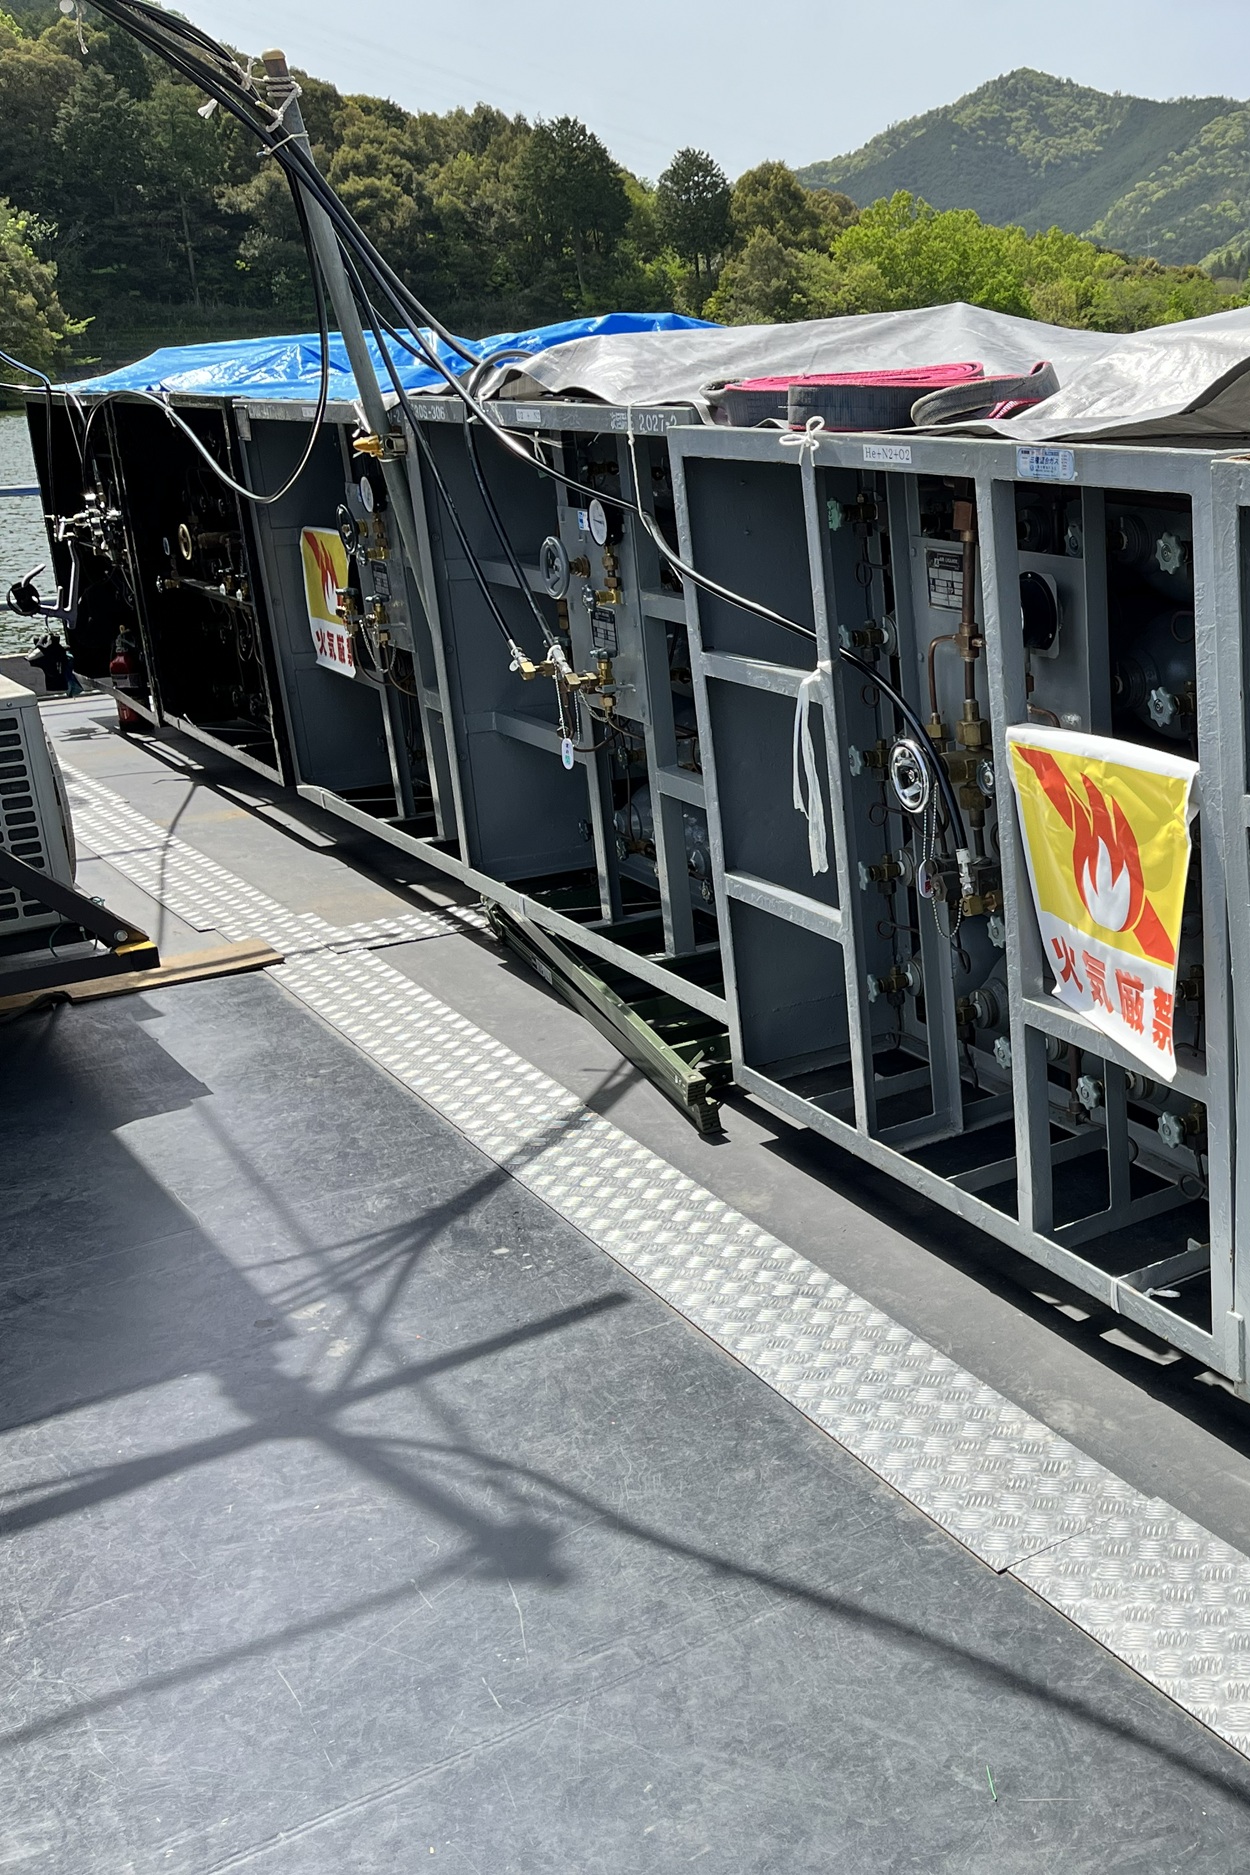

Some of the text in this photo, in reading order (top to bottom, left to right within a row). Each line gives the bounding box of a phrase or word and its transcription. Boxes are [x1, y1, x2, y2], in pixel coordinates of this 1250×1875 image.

[865, 446, 910, 461] He+N2+O2
[1051, 936, 1173, 1056] 火気厳禁
